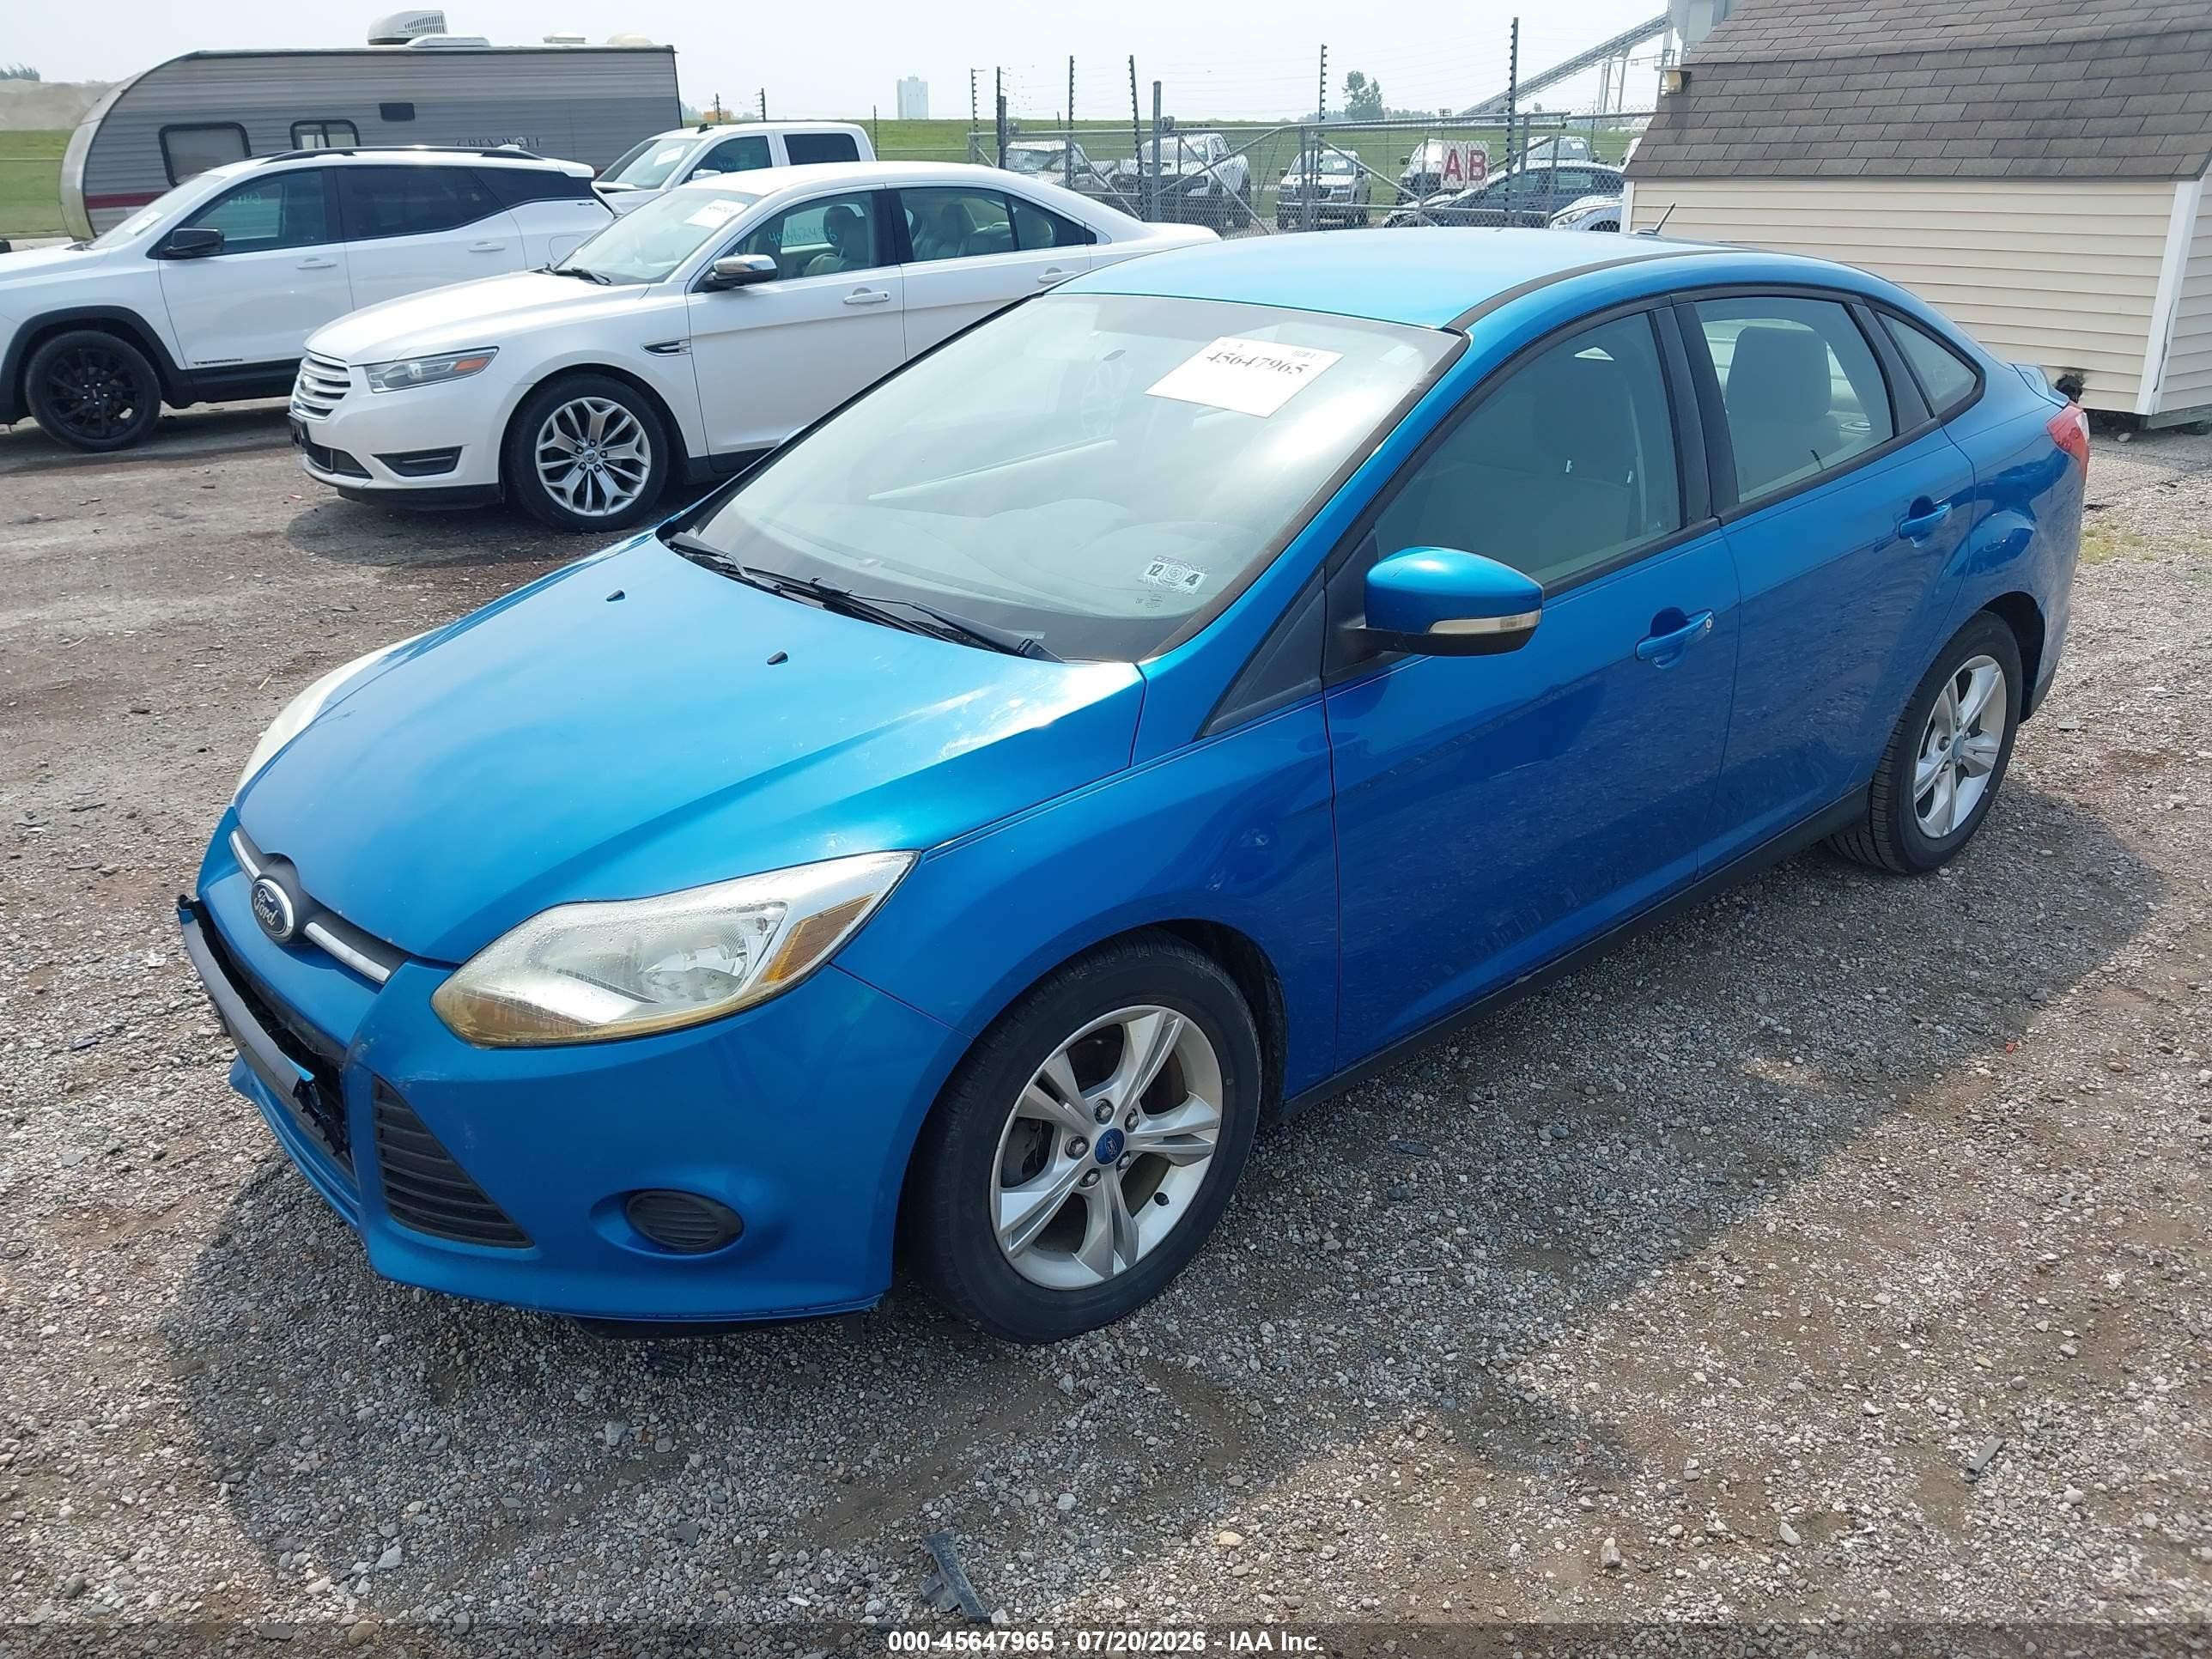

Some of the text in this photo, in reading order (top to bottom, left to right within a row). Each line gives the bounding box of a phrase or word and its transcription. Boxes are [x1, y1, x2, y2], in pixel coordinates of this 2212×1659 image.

[1206, 351, 1310, 375] 45647965
[1147, 563, 1164, 577] 12
[1185, 573, 1200, 586] 4
[253, 888, 279, 927] Ford
